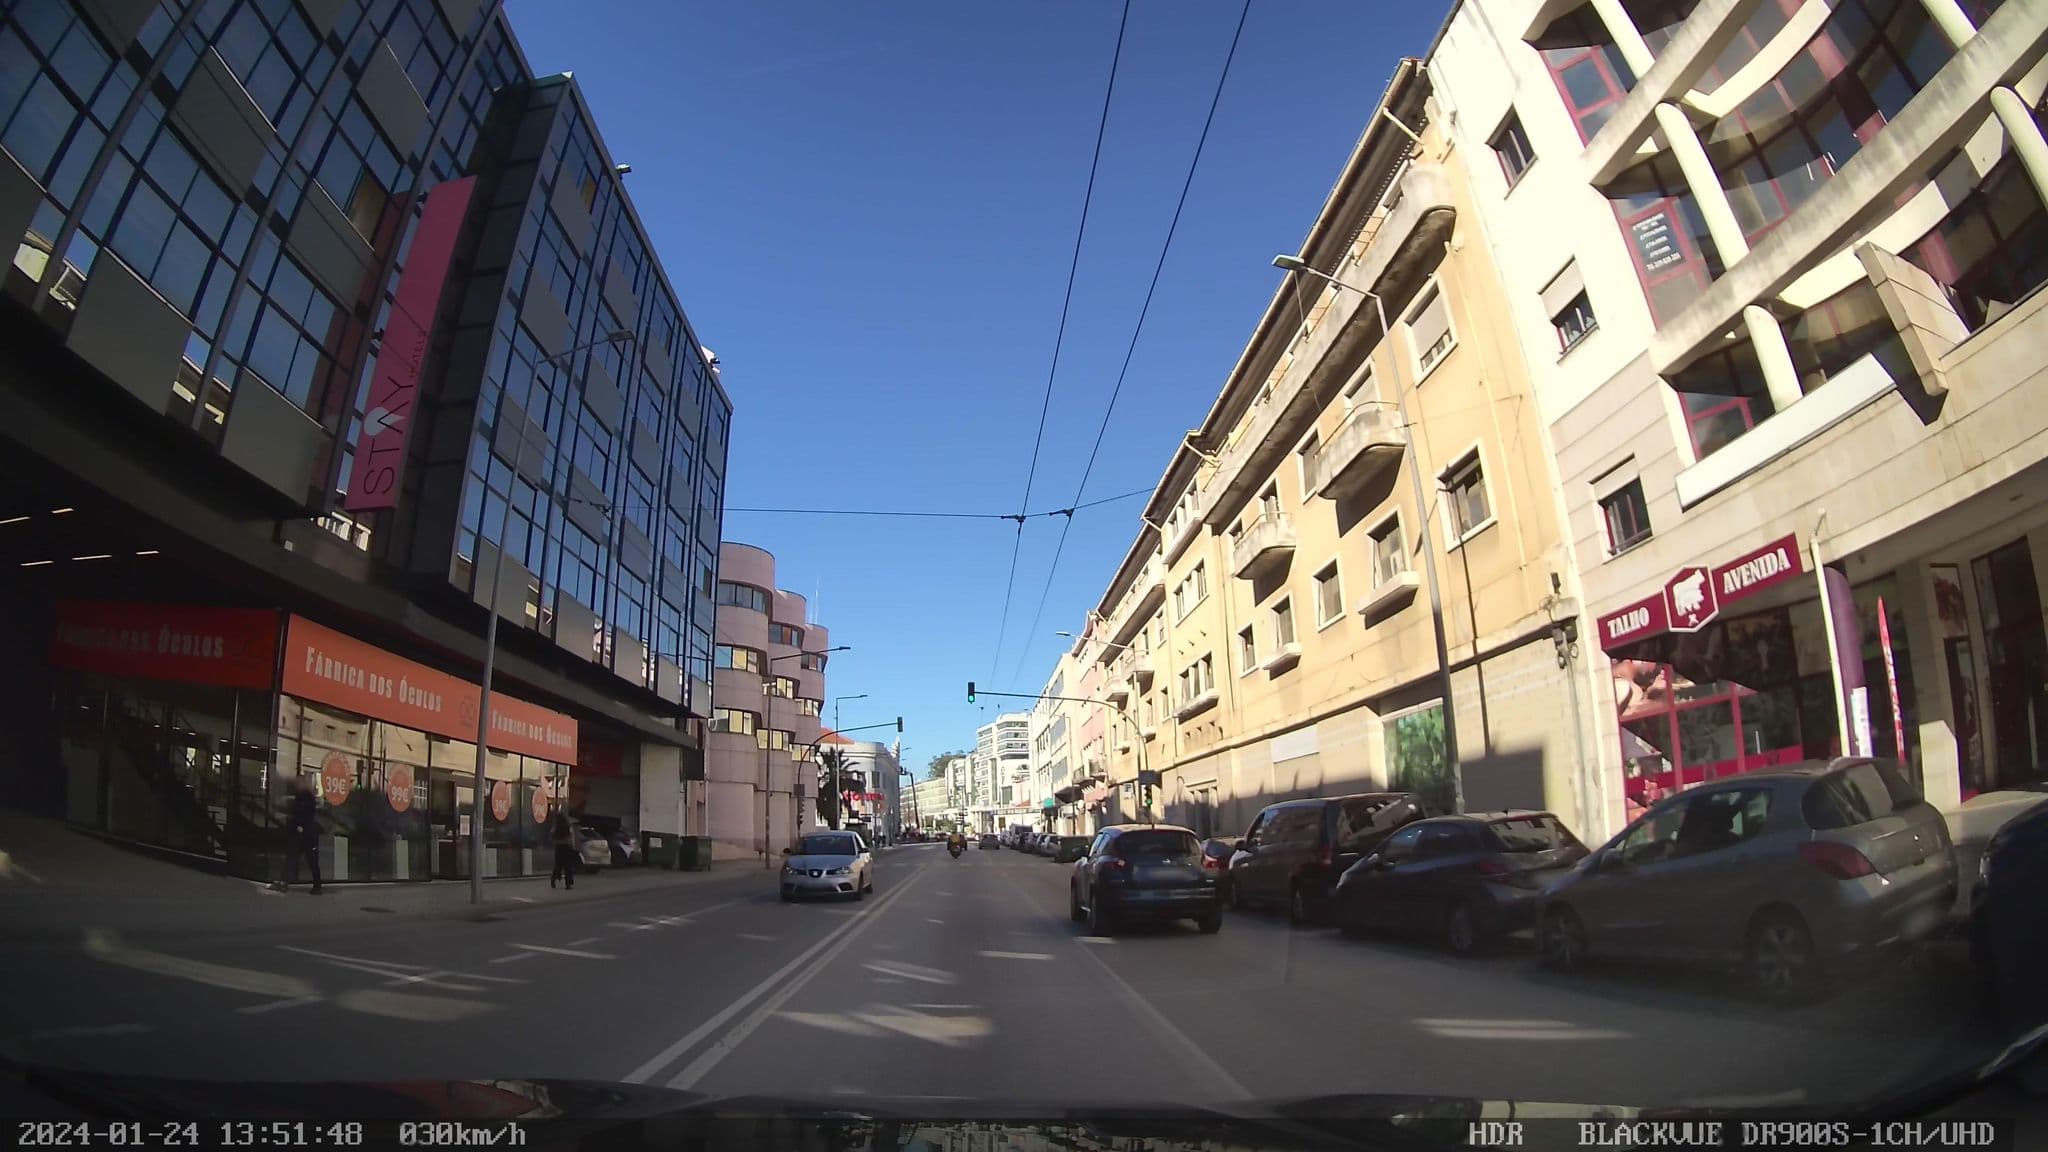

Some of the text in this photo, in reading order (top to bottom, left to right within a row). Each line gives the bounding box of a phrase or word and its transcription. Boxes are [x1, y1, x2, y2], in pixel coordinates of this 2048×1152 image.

[363, 376, 413, 495] STAY
[1607, 547, 1791, 639] TALHO AVENIDA
[305, 646, 442, 712] FÁBRICA DOS ÓCULOS
[529, 724, 544, 742] DOS
[325, 776, 346, 794] 39€
[391, 785, 409, 802] 99€
